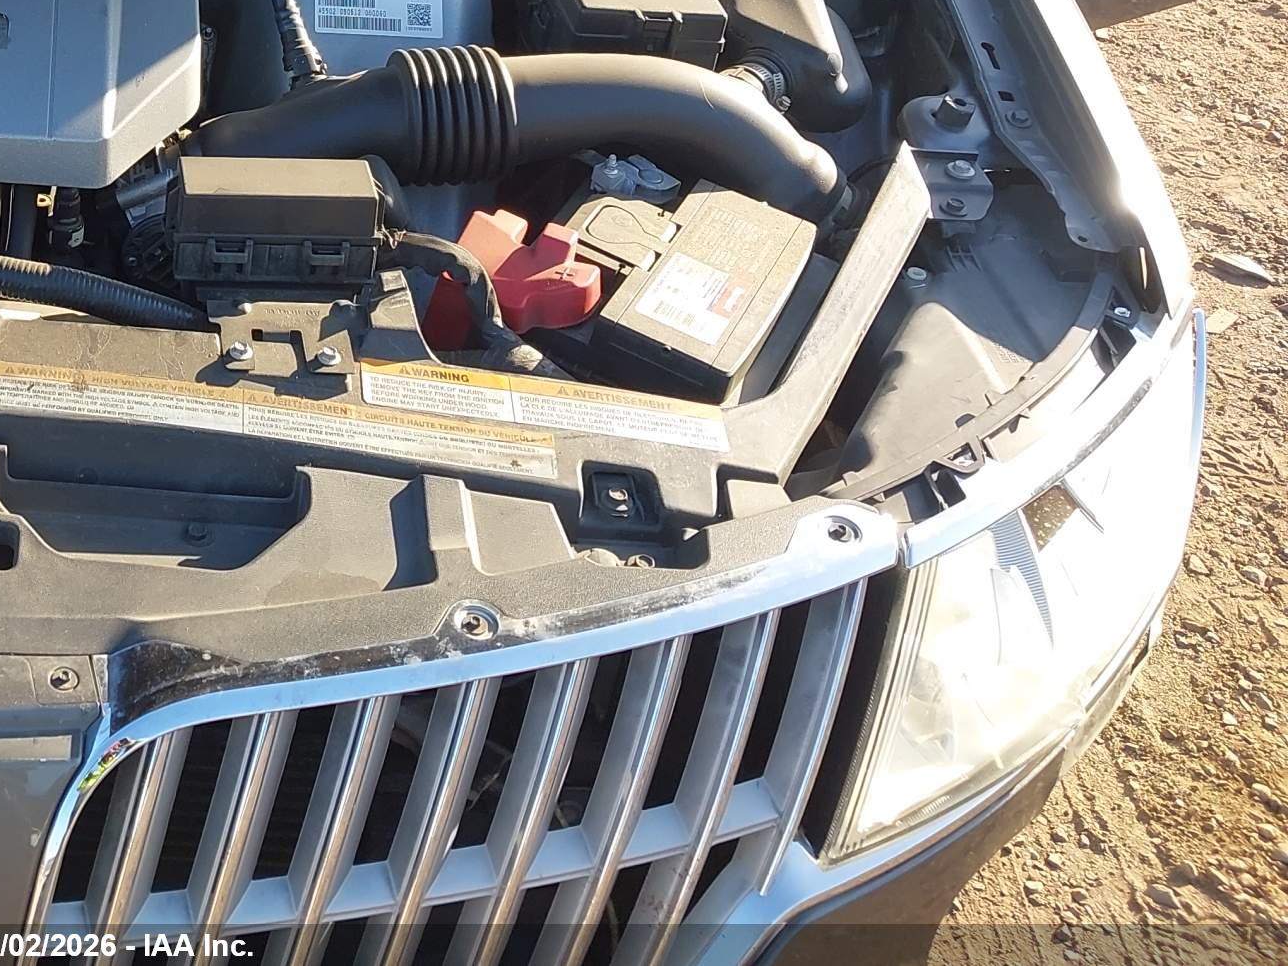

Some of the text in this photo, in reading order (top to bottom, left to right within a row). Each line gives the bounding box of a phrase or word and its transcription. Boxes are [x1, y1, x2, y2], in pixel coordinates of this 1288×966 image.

[20, 368, 215, 396] WARNING HIGH VOLTAGE VEHICLE
[412, 367, 470, 383] WARNING
[412, 381, 426, 389] THE
[402, 392, 437, 403] WORKING
[439, 397, 464, 406] UNDER
[434, 391, 456, 399] FROM
[572, 389, 672, 410] AVERTISSEMENT
[263, 394, 353, 415] AVERTISSEMENT
[365, 413, 405, 424] CIRCUITS
[407, 418, 436, 429] HAUTE
[439, 424, 476, 434] TENSION
